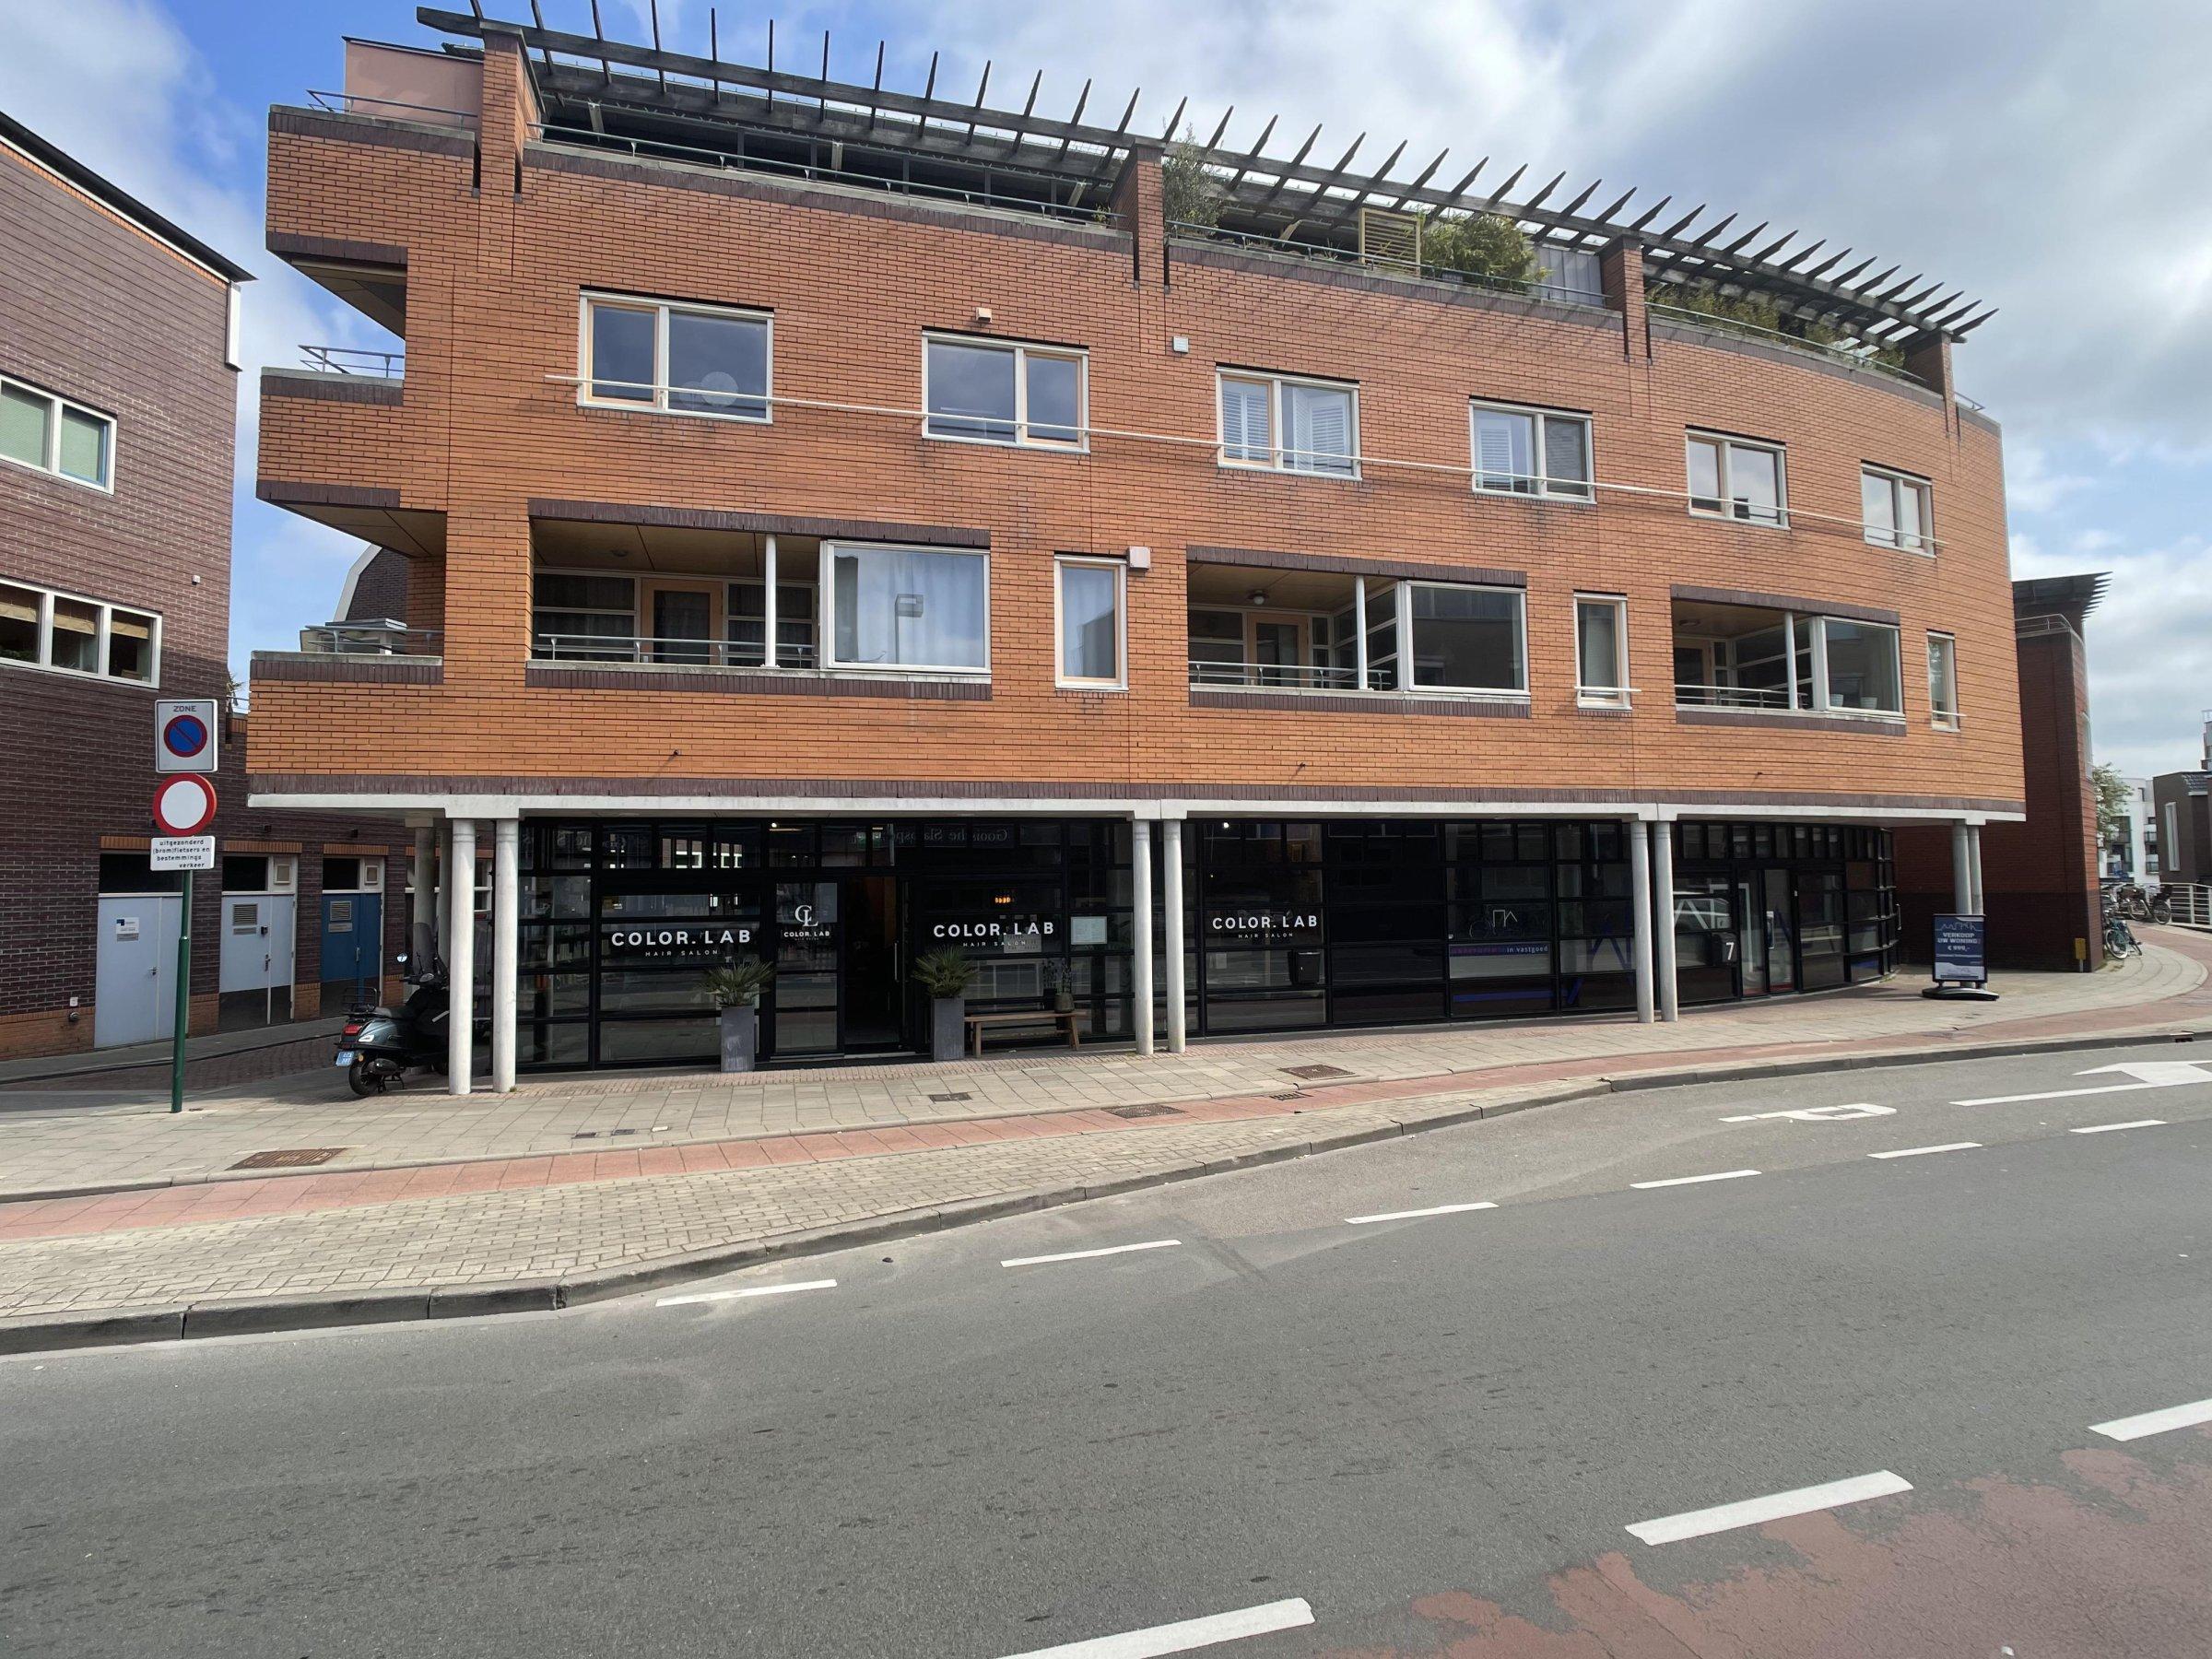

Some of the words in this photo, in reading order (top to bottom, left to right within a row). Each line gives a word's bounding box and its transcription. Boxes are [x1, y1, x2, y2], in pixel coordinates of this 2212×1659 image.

[1282, 915, 1317, 928] LAB
[1014, 922, 1054, 935] LAB
[704, 929, 751, 945] LAB
[1516, 946, 1548, 954] vastgoed
[1725, 941, 1735, 960] 7
